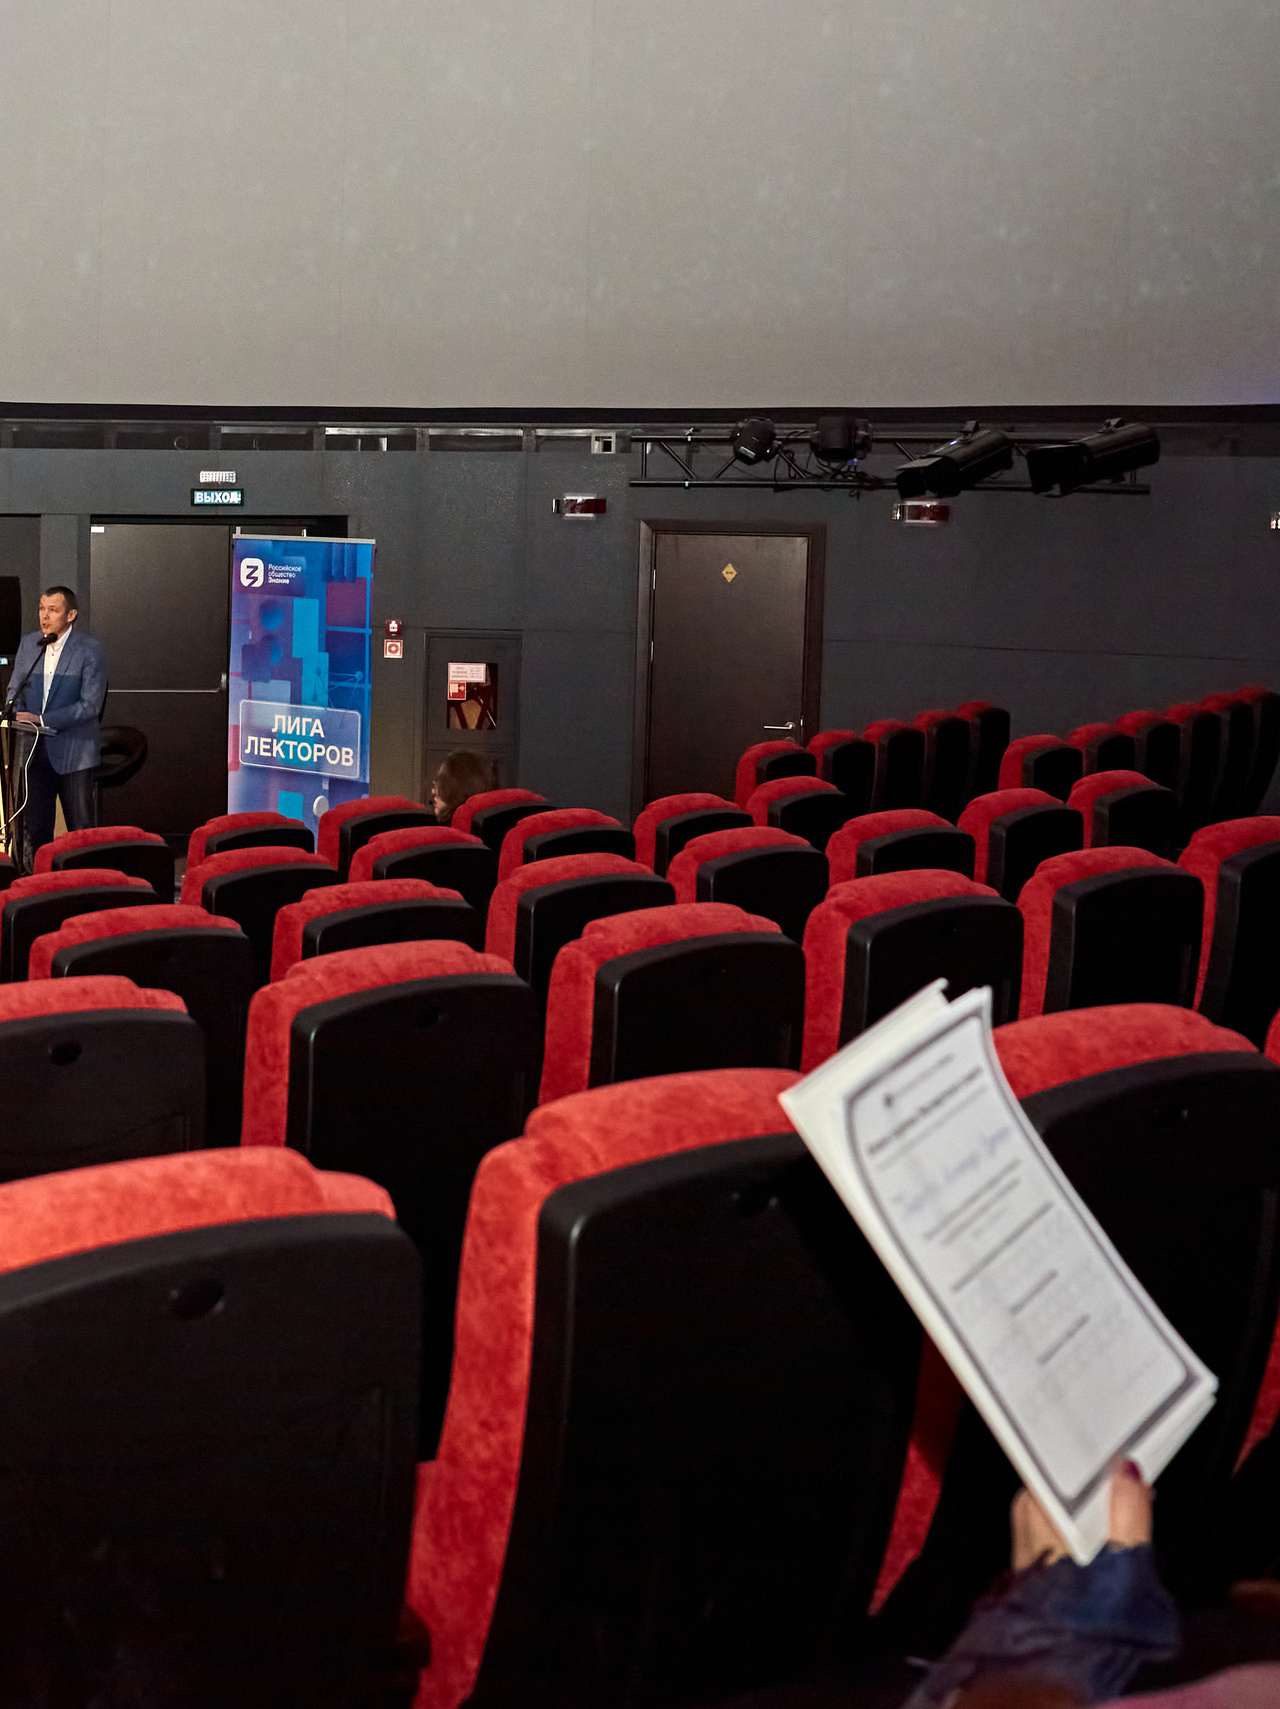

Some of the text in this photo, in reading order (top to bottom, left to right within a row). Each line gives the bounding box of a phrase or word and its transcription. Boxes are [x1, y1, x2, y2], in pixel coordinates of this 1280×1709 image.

[196, 491, 239, 503] ВЫХОД
[268, 563, 302, 572] Российское
[268, 576, 290, 584] Знание
[271, 714, 325, 738] ЛИГА
[244, 735, 354, 766] ЛЕКТОРОВ
